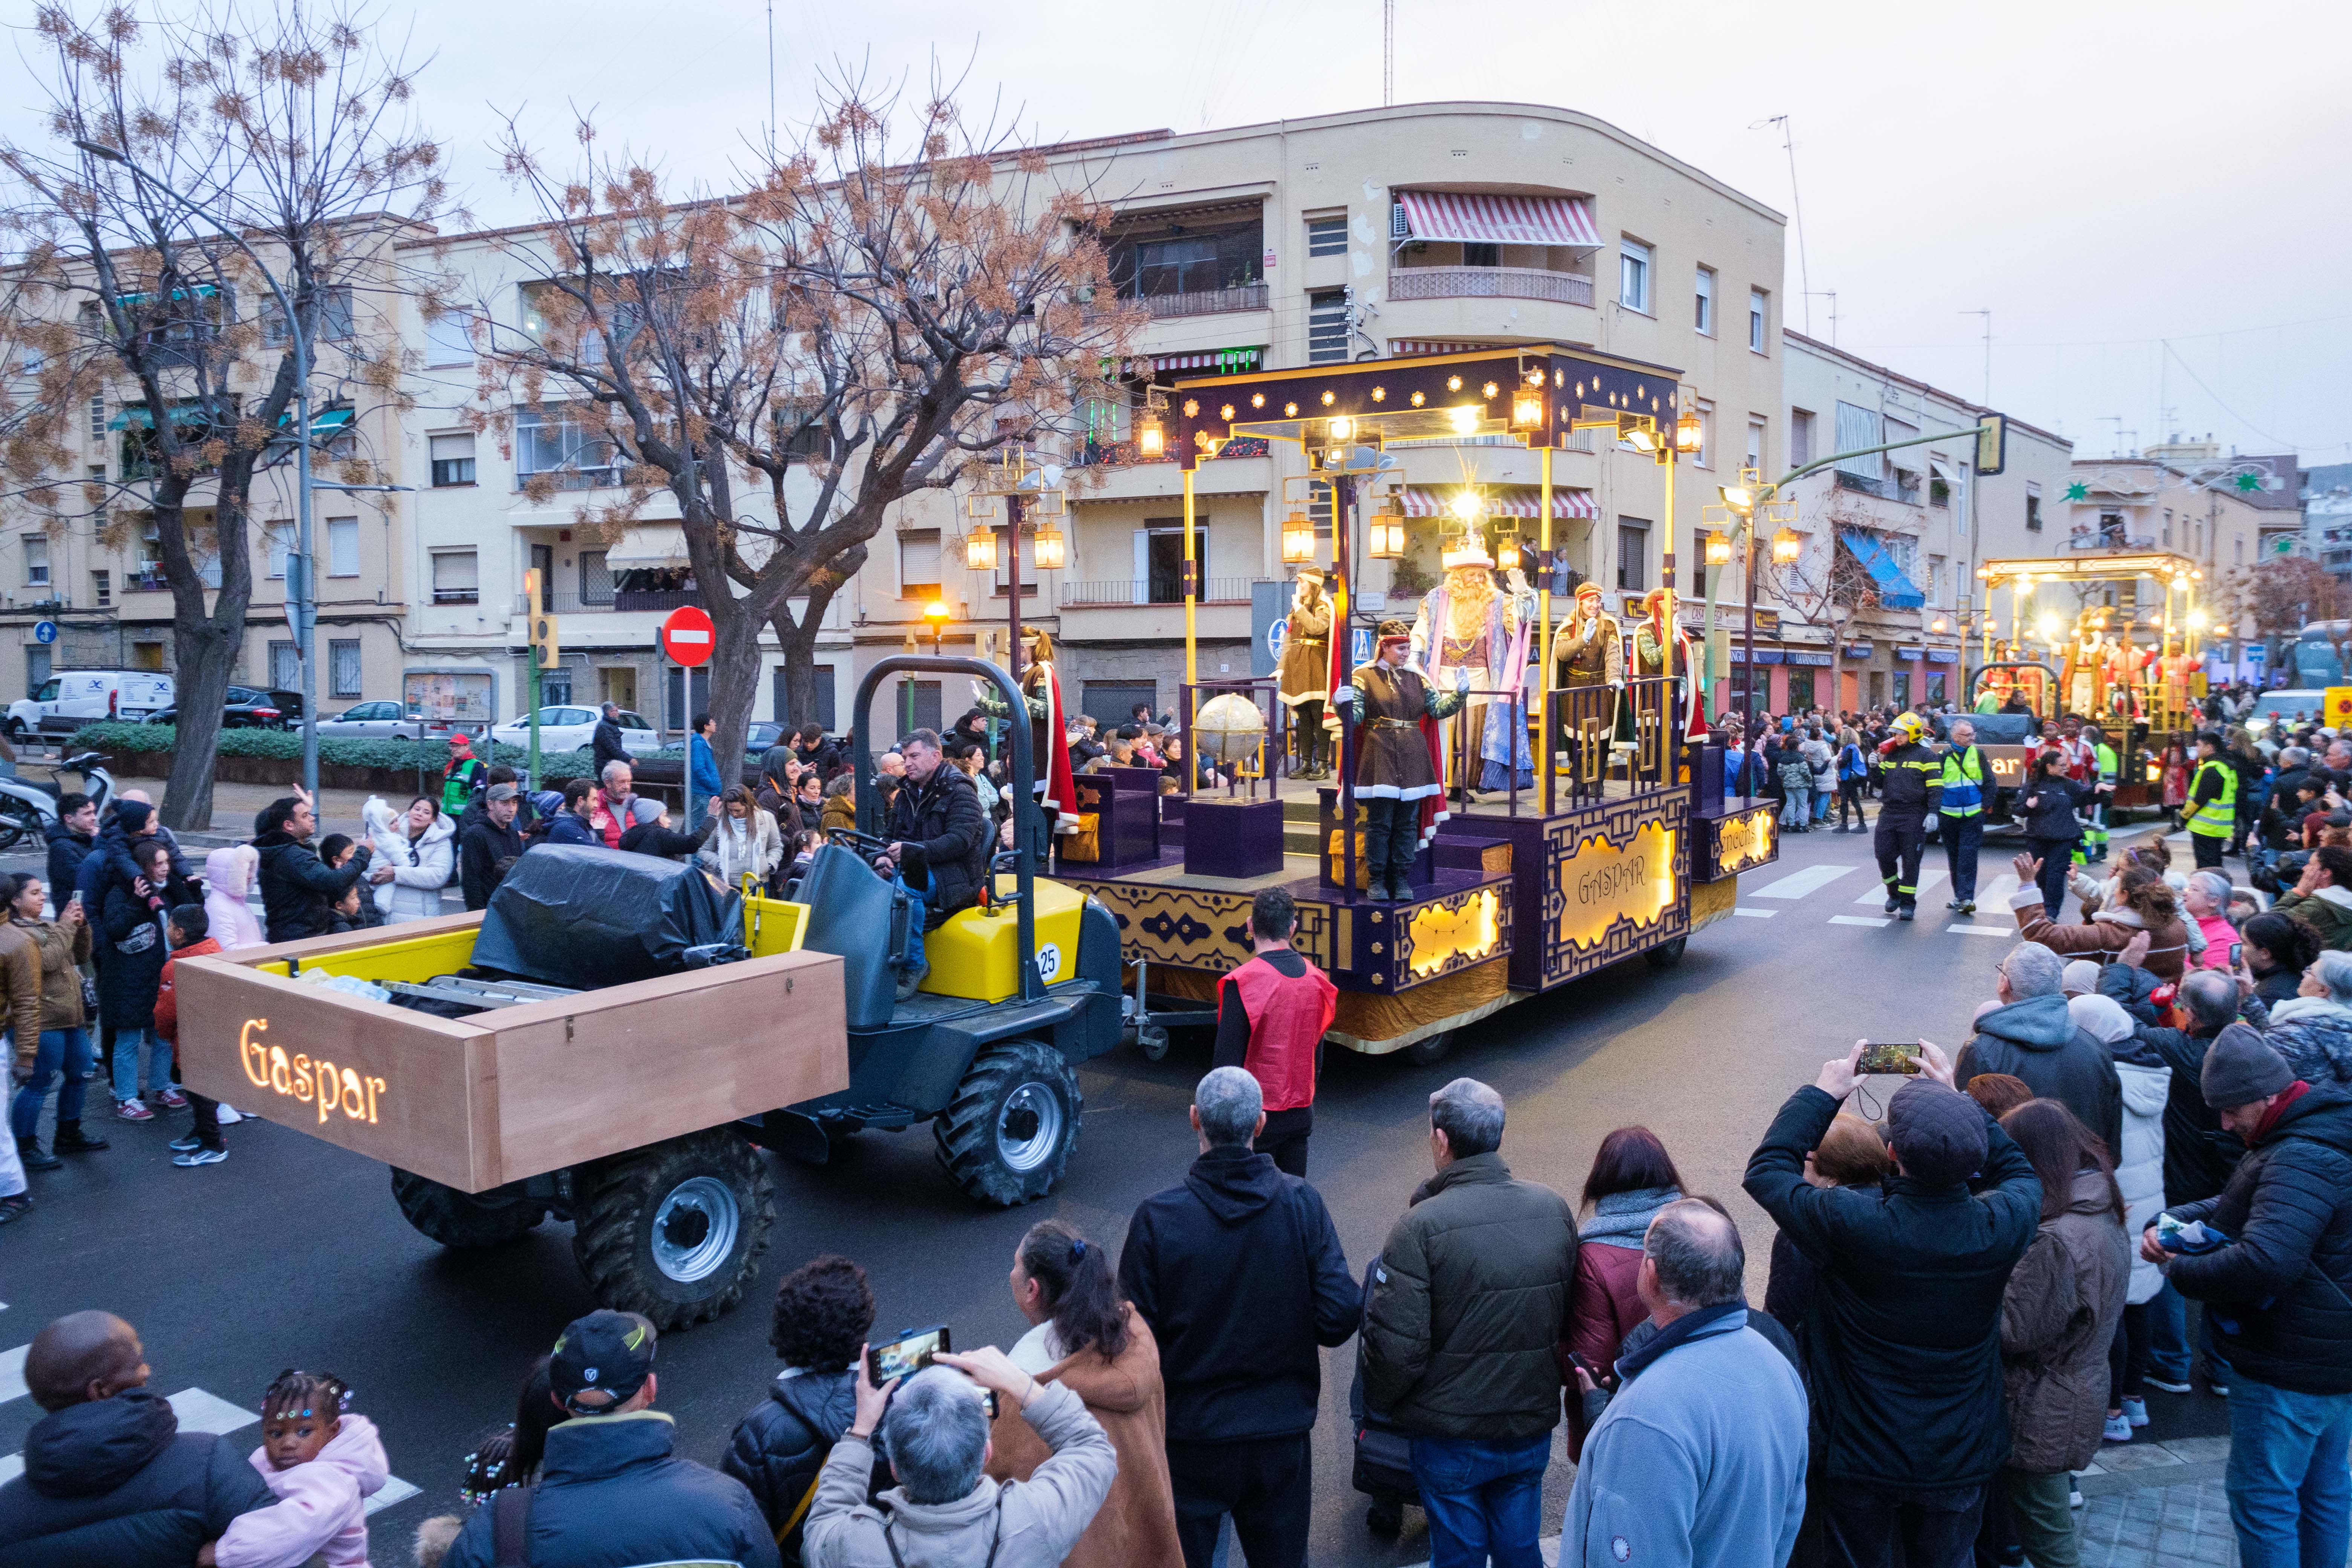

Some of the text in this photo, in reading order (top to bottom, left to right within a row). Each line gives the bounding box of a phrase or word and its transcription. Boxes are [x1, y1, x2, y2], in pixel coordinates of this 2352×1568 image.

[1692, 607, 1704, 620] CASA
[1714, 610, 1722, 622] EGA
[1578, 855, 1645, 905] GASPAR
[1041, 949, 1055, 975] 25
[239, 1018, 387, 1125] Gaspar
